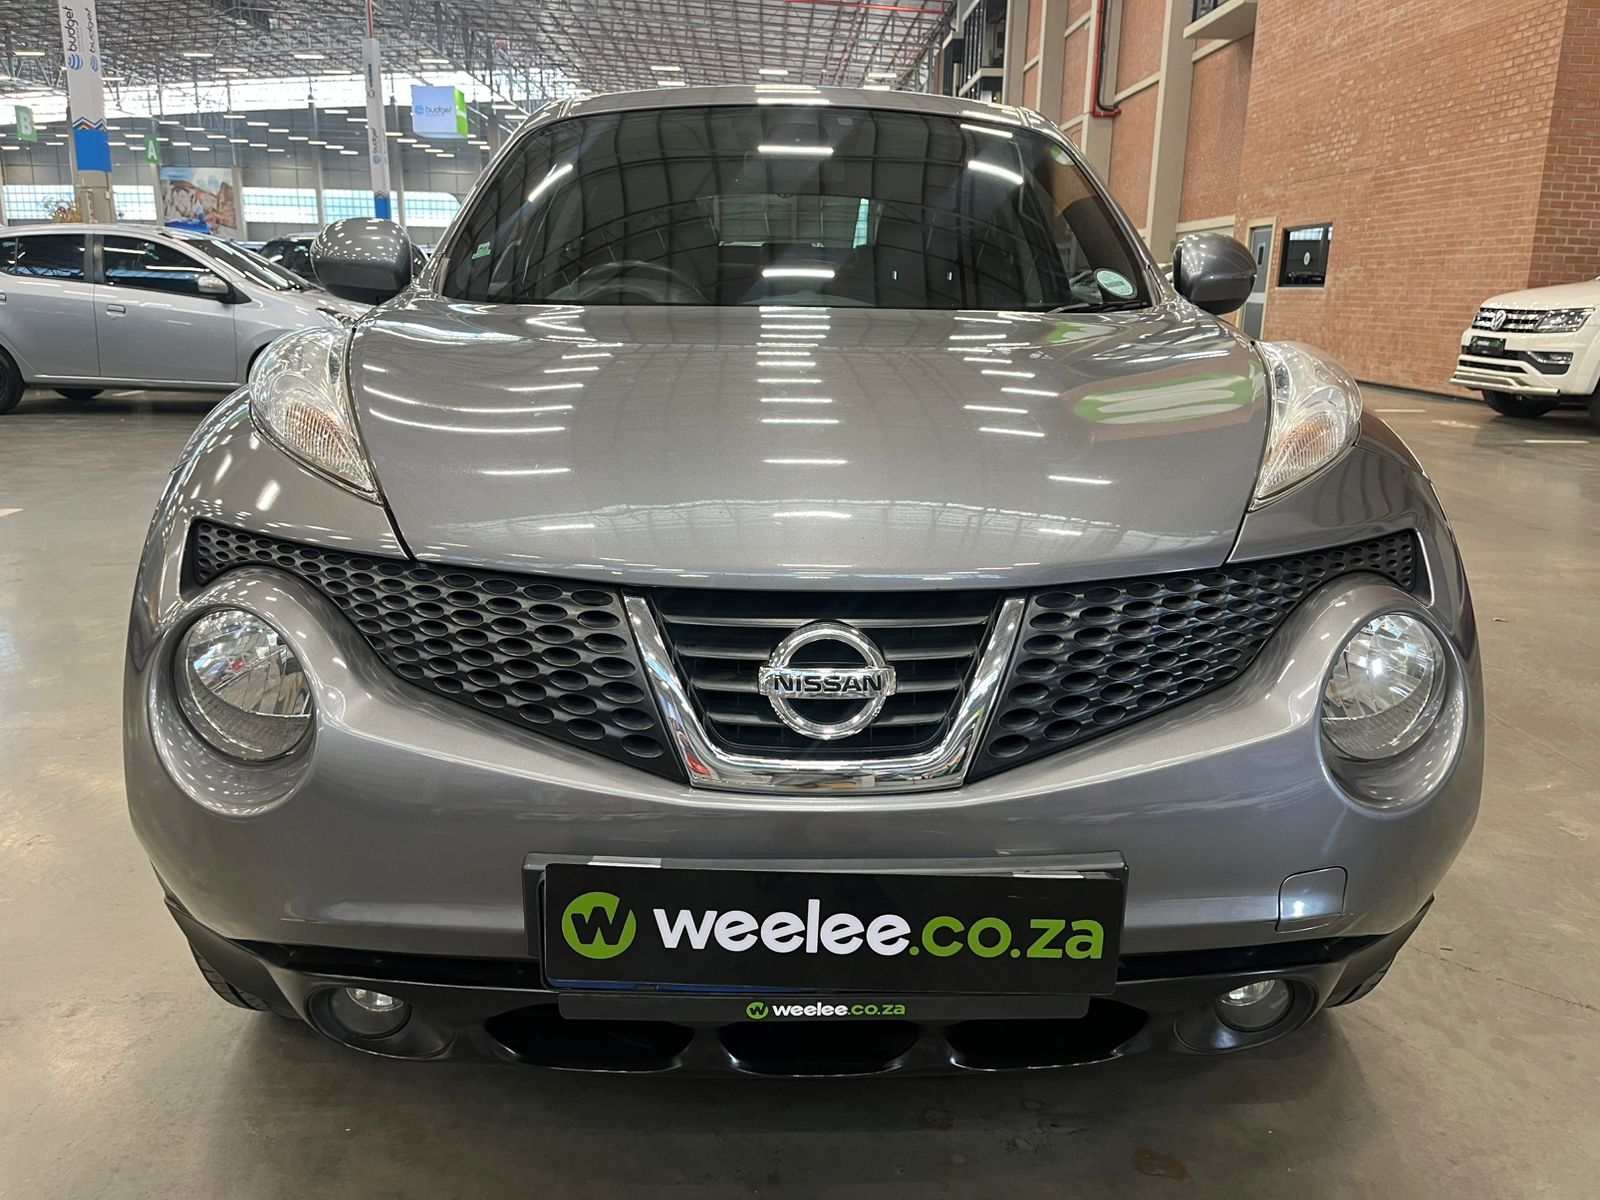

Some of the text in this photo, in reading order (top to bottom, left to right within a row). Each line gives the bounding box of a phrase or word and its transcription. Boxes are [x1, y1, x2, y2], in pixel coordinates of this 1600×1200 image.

[62, 6, 78, 52] budget
[84, 8, 96, 53] budget
[20, 110, 32, 135] B
[147, 139, 158, 160] A
[774, 674, 881, 693] NISSAN
[653, 898, 1105, 961] weelee.co.za
[772, 1001, 906, 1017] weelee.co.za
